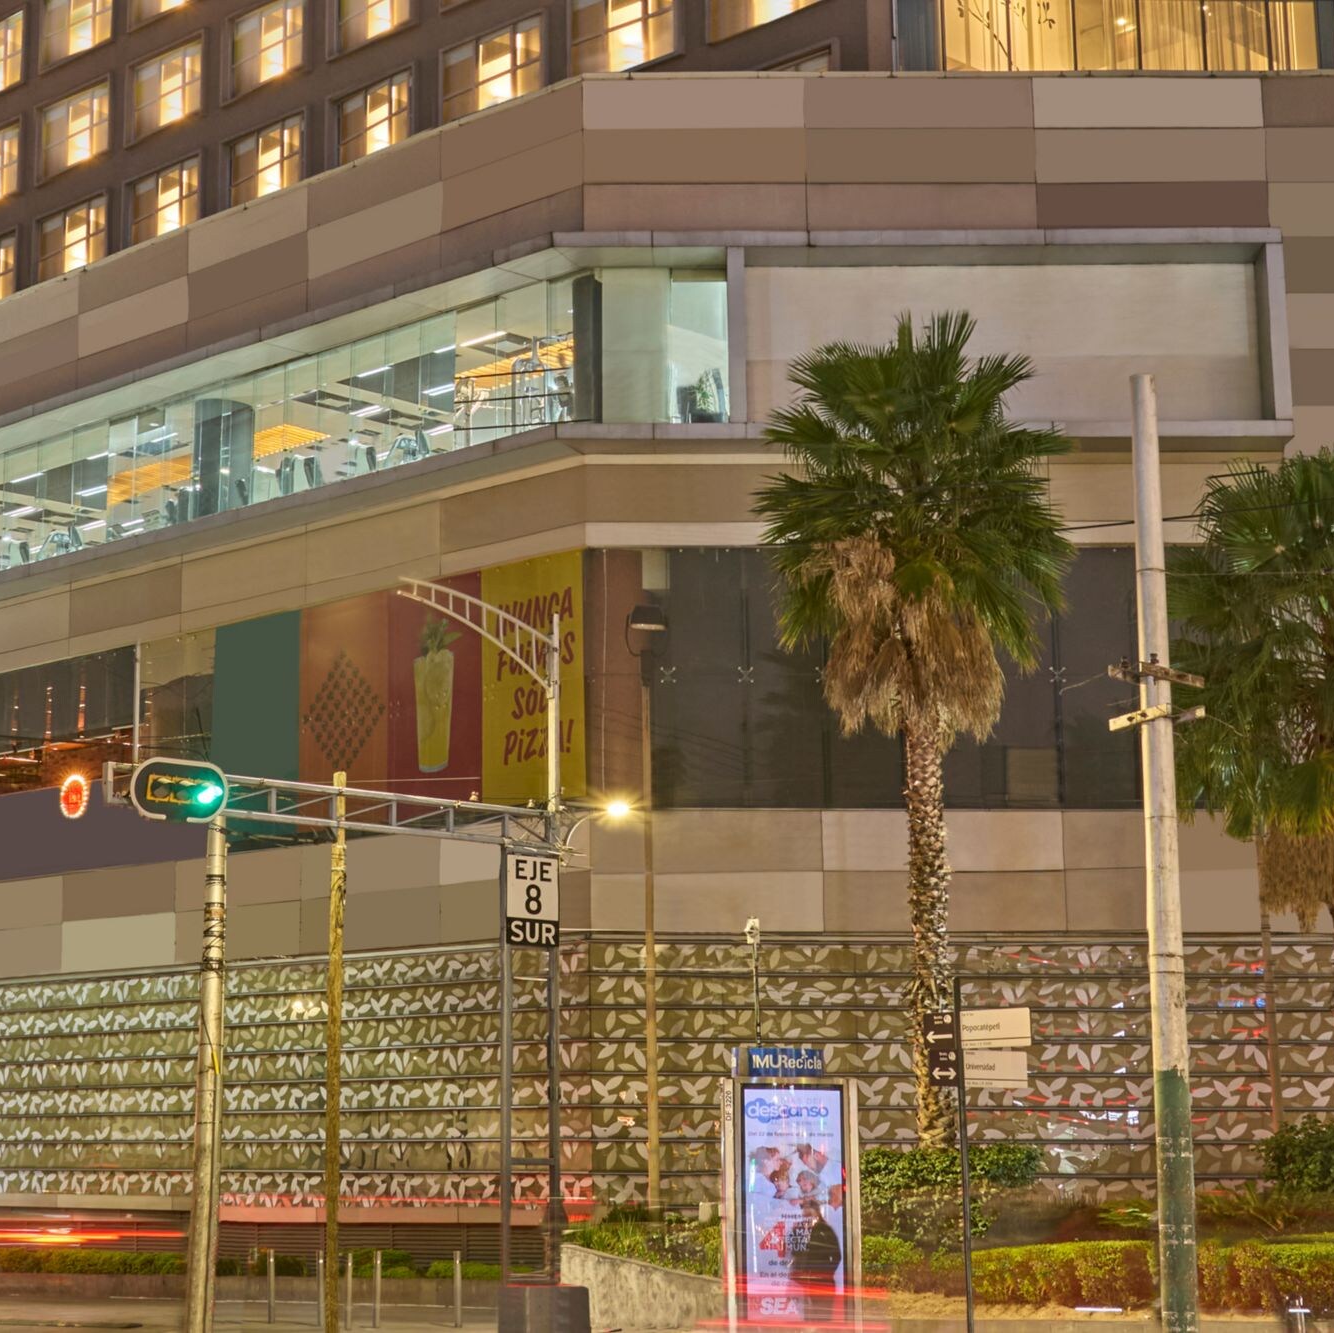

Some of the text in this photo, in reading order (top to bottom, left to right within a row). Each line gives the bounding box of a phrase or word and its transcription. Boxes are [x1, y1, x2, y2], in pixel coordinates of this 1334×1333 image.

[511, 679, 561, 720] SÓL
[515, 859, 552, 882] EJE
[525, 884, 542, 915] 8
[510, 920, 556, 945] SUR
[747, 1101, 829, 1118] descanso
